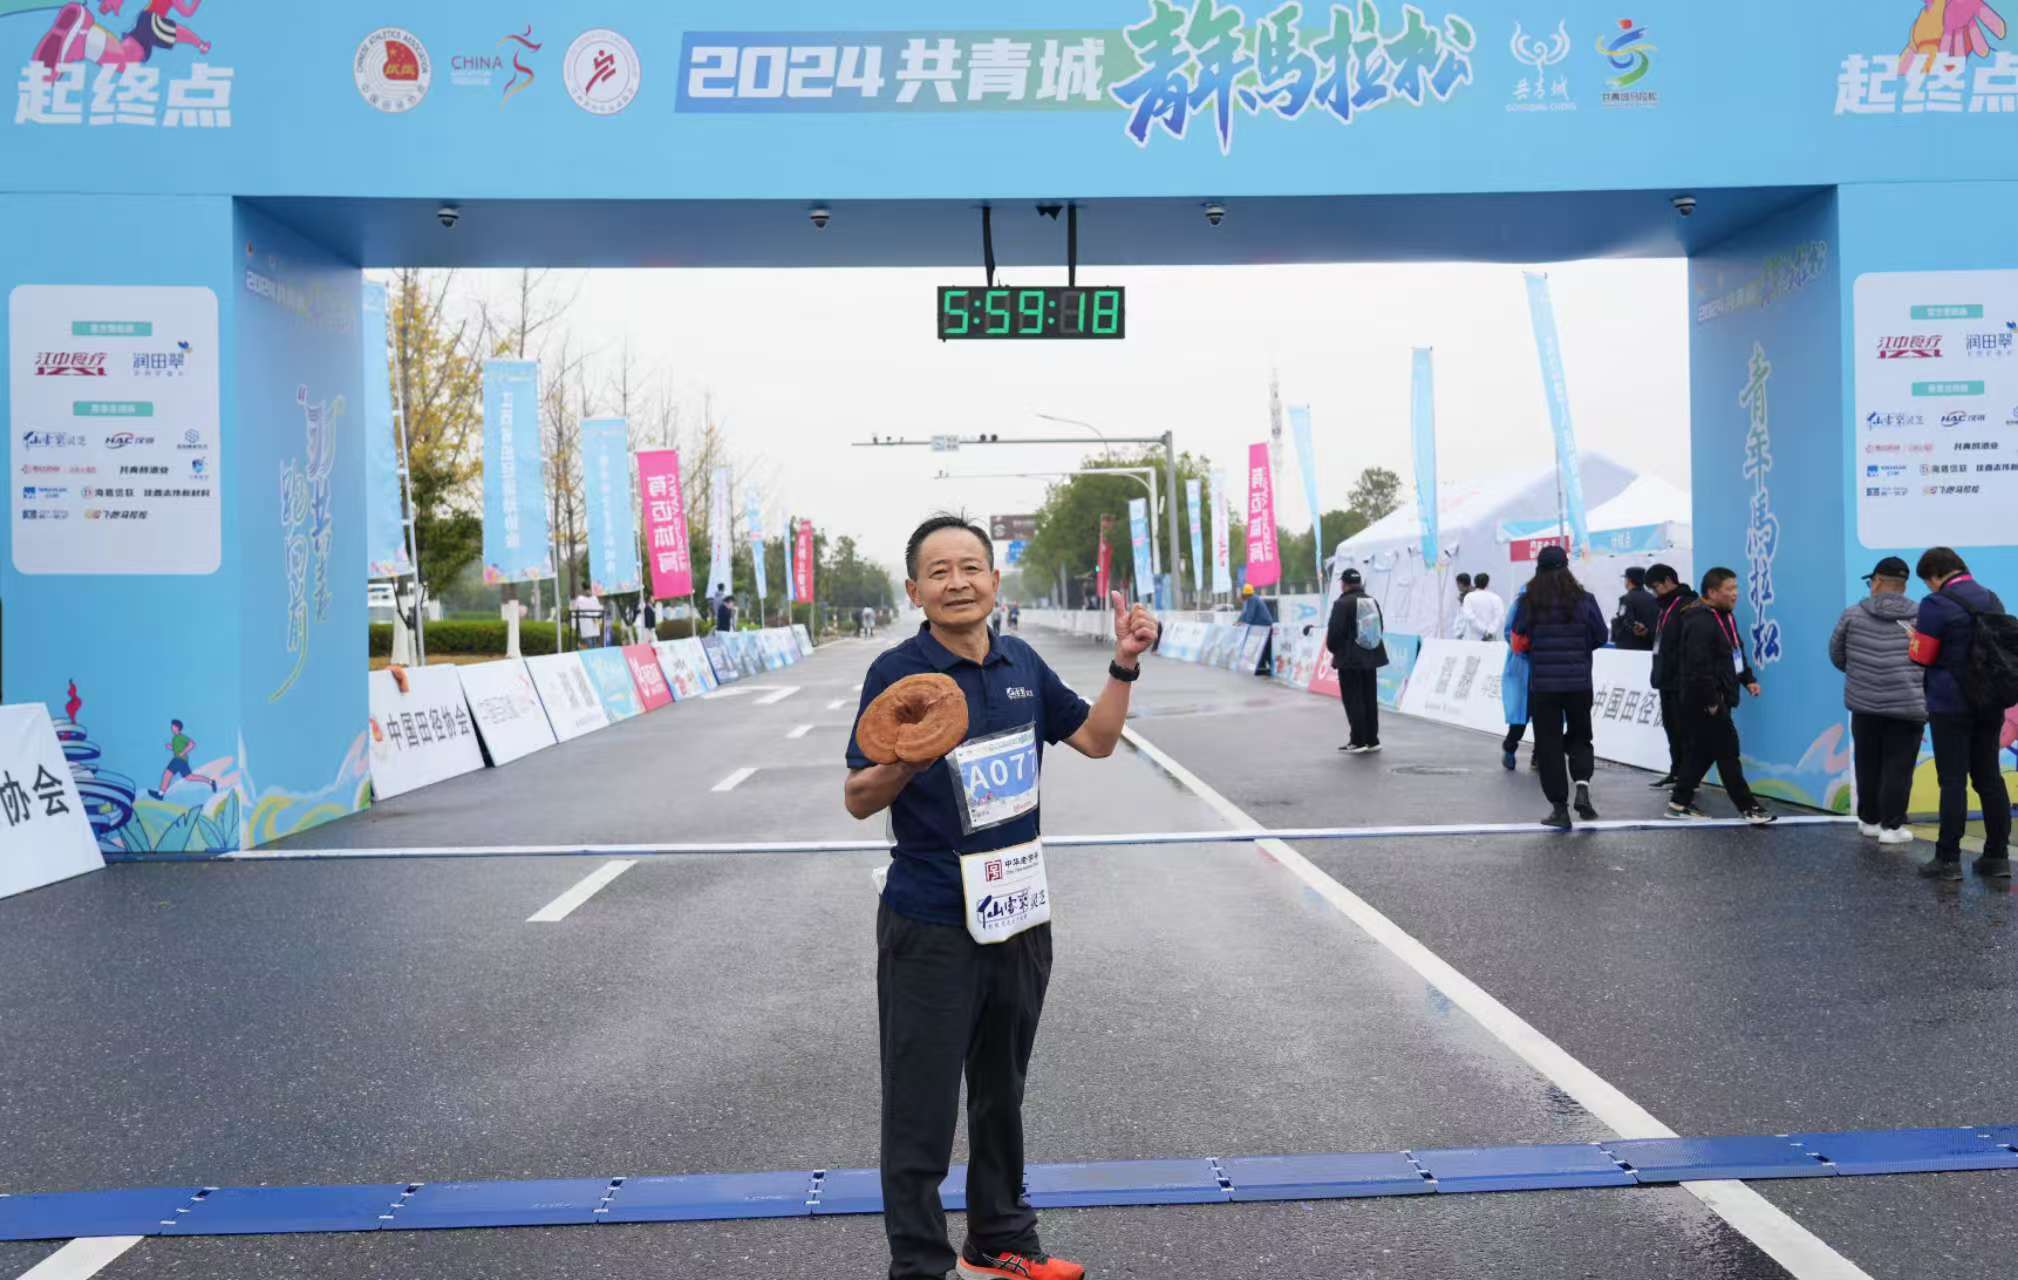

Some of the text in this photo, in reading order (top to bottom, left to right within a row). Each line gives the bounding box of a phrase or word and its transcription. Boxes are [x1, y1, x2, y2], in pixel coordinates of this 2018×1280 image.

[451, 55, 503, 70] CHINA
[15, 59, 235, 128] 起终点
[944, 290, 1120, 334] 5:59:18
[1877, 335, 1943, 349] 江中食疗
[35, 351, 107, 366] 江中食疗
[386, 706, 471, 751] 中国田径协会
